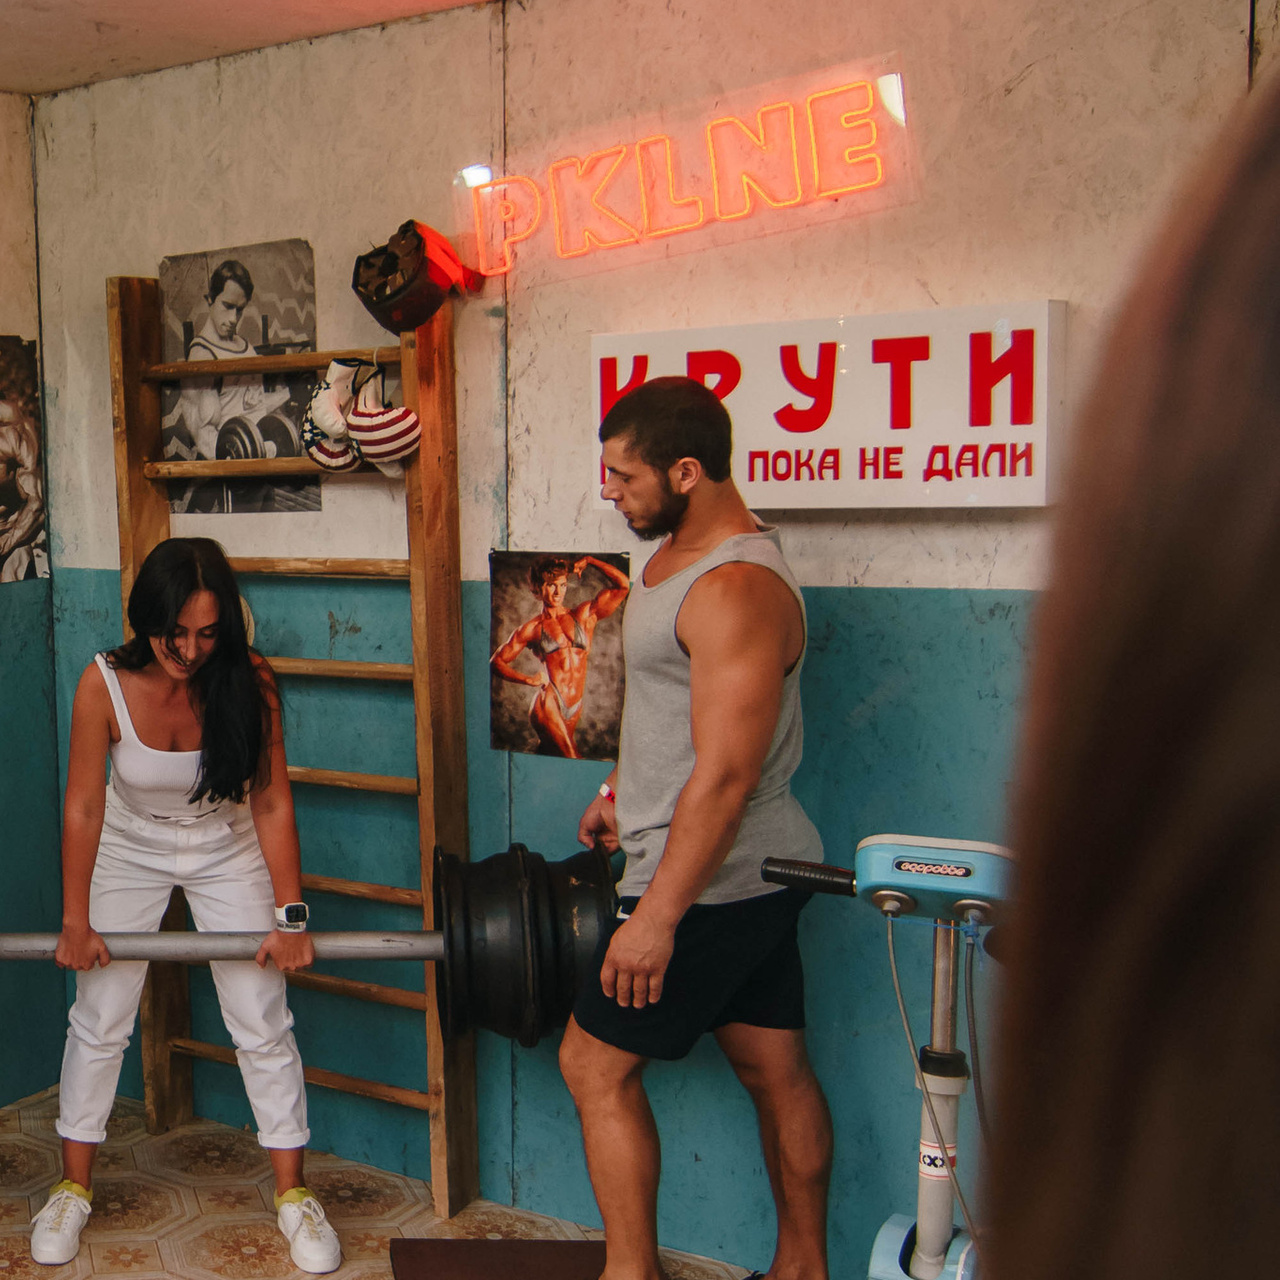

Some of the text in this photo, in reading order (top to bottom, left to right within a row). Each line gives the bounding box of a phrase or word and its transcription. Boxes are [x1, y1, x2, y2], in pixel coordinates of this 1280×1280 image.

[473, 80, 883, 277] PKLNE
[748, 442, 1033, 483] ПОКА НЕ ДАЛИ
